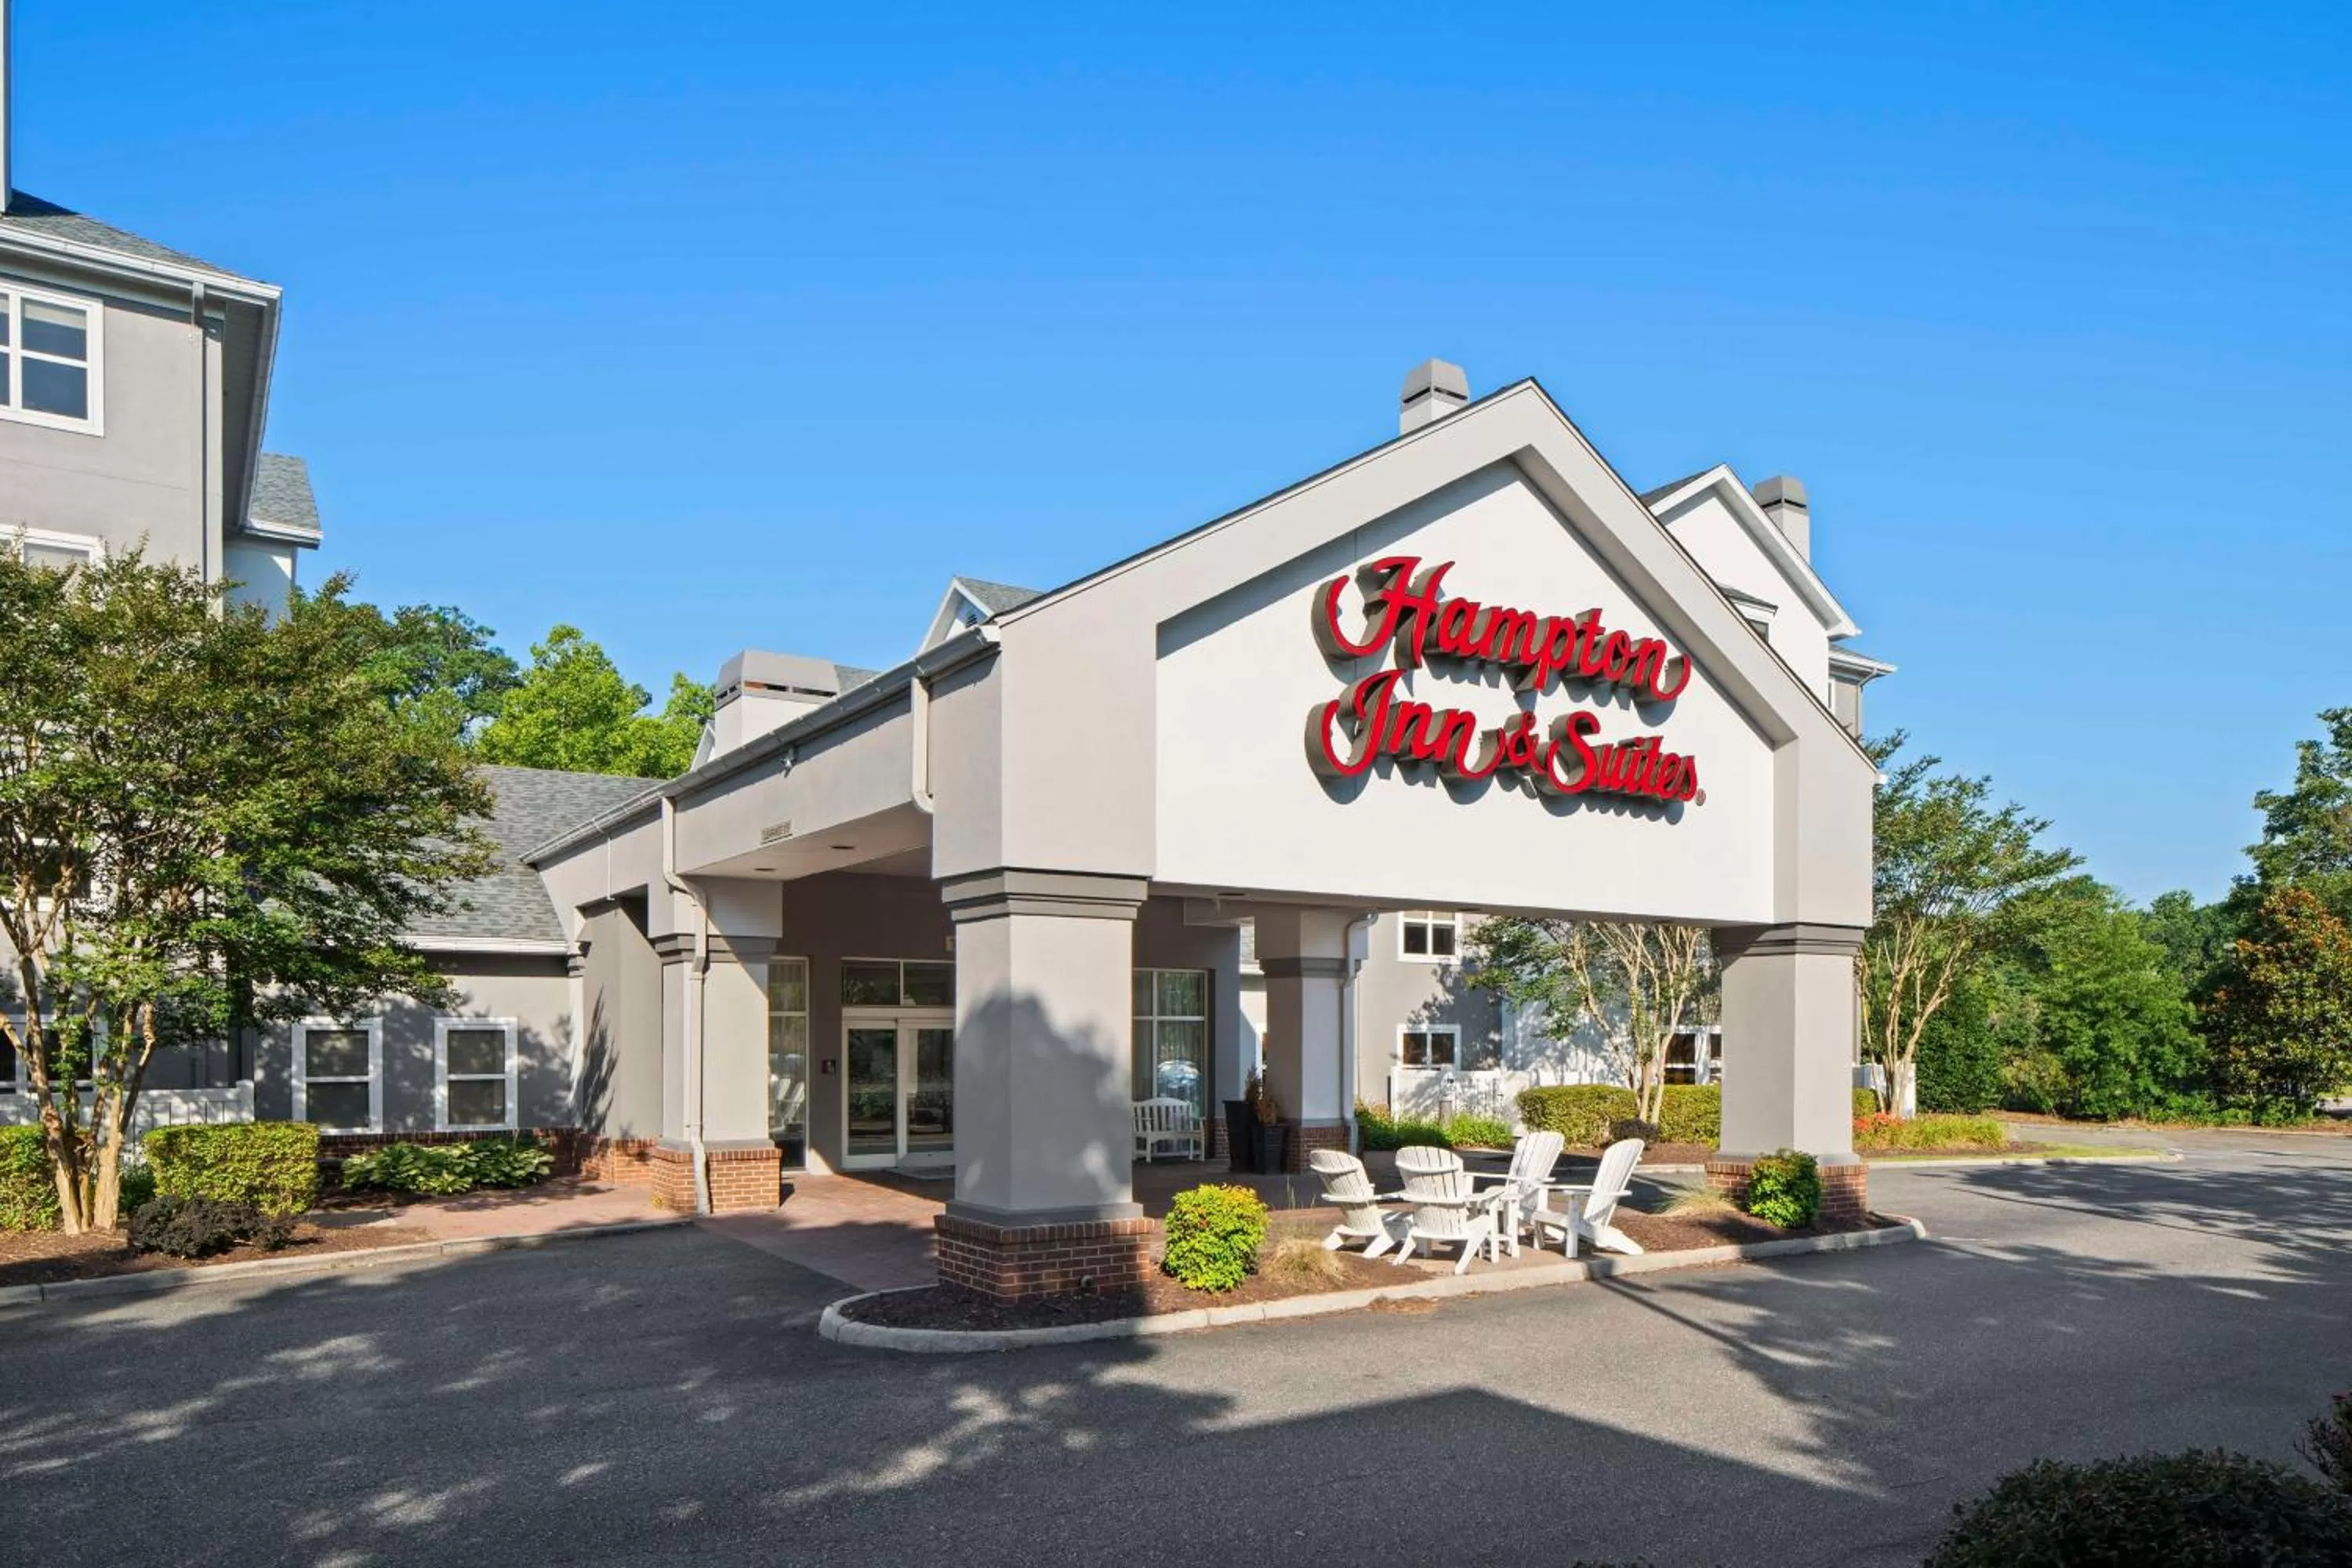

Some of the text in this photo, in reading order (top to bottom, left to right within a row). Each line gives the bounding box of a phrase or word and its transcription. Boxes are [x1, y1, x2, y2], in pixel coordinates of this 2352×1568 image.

[1325, 556, 1691, 701] Hampton
[1320, 669, 1505, 779] Inn
[1507, 711, 1547, 775] &
